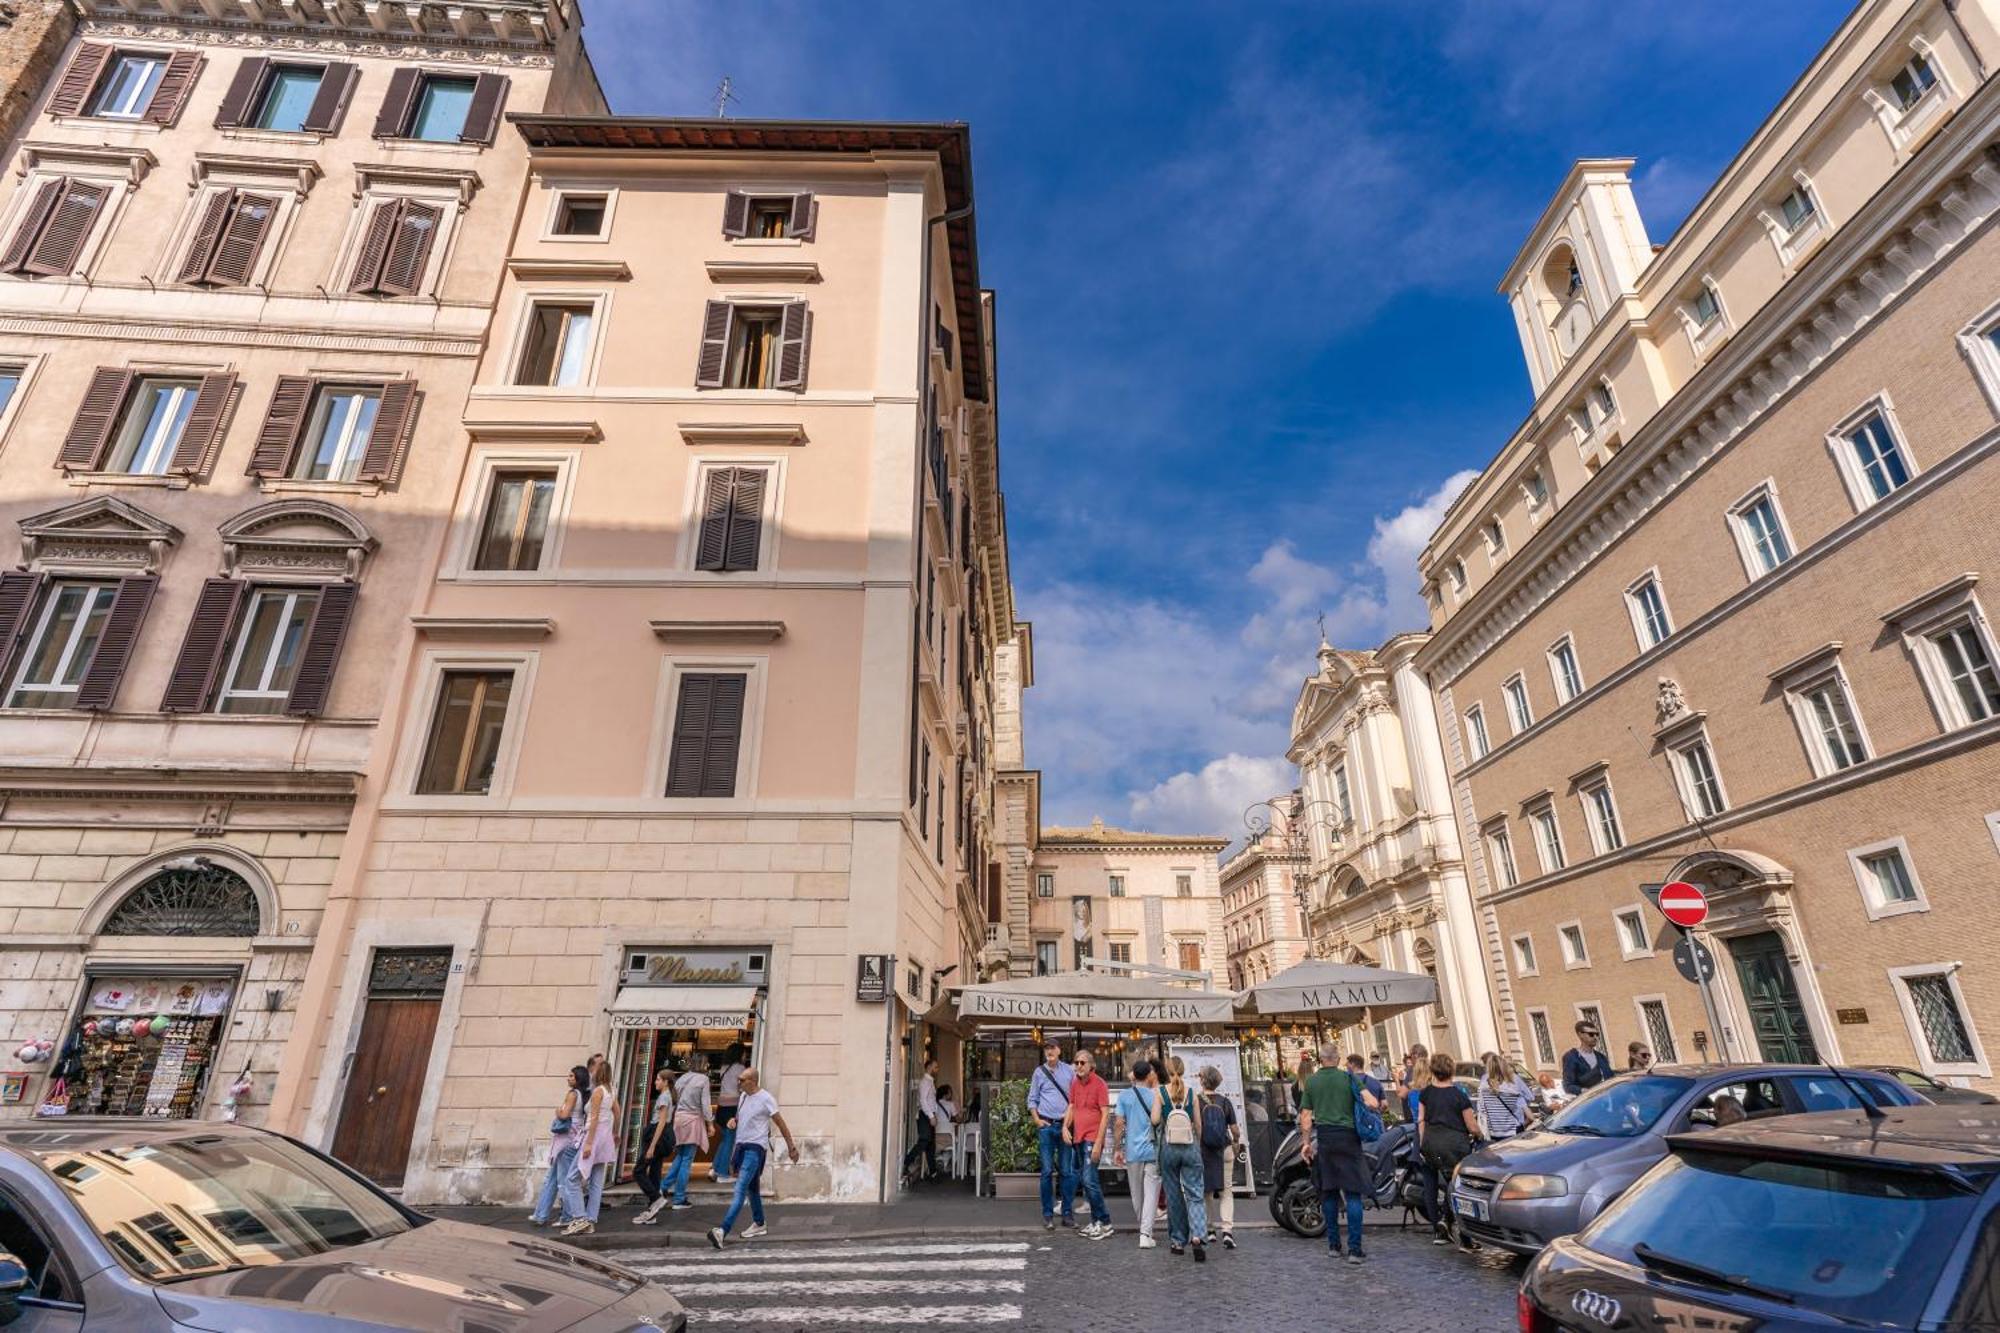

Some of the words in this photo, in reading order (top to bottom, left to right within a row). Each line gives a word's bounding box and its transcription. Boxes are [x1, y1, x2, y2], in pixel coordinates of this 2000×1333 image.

[976, 995, 1095, 1018] RISTORANTE
[1116, 1002, 1200, 1019] PIZZERIA
[614, 1016, 651, 1026] PIZZA
[657, 1016, 697, 1026] FOOD
[702, 1016, 744, 1026] DRINK
